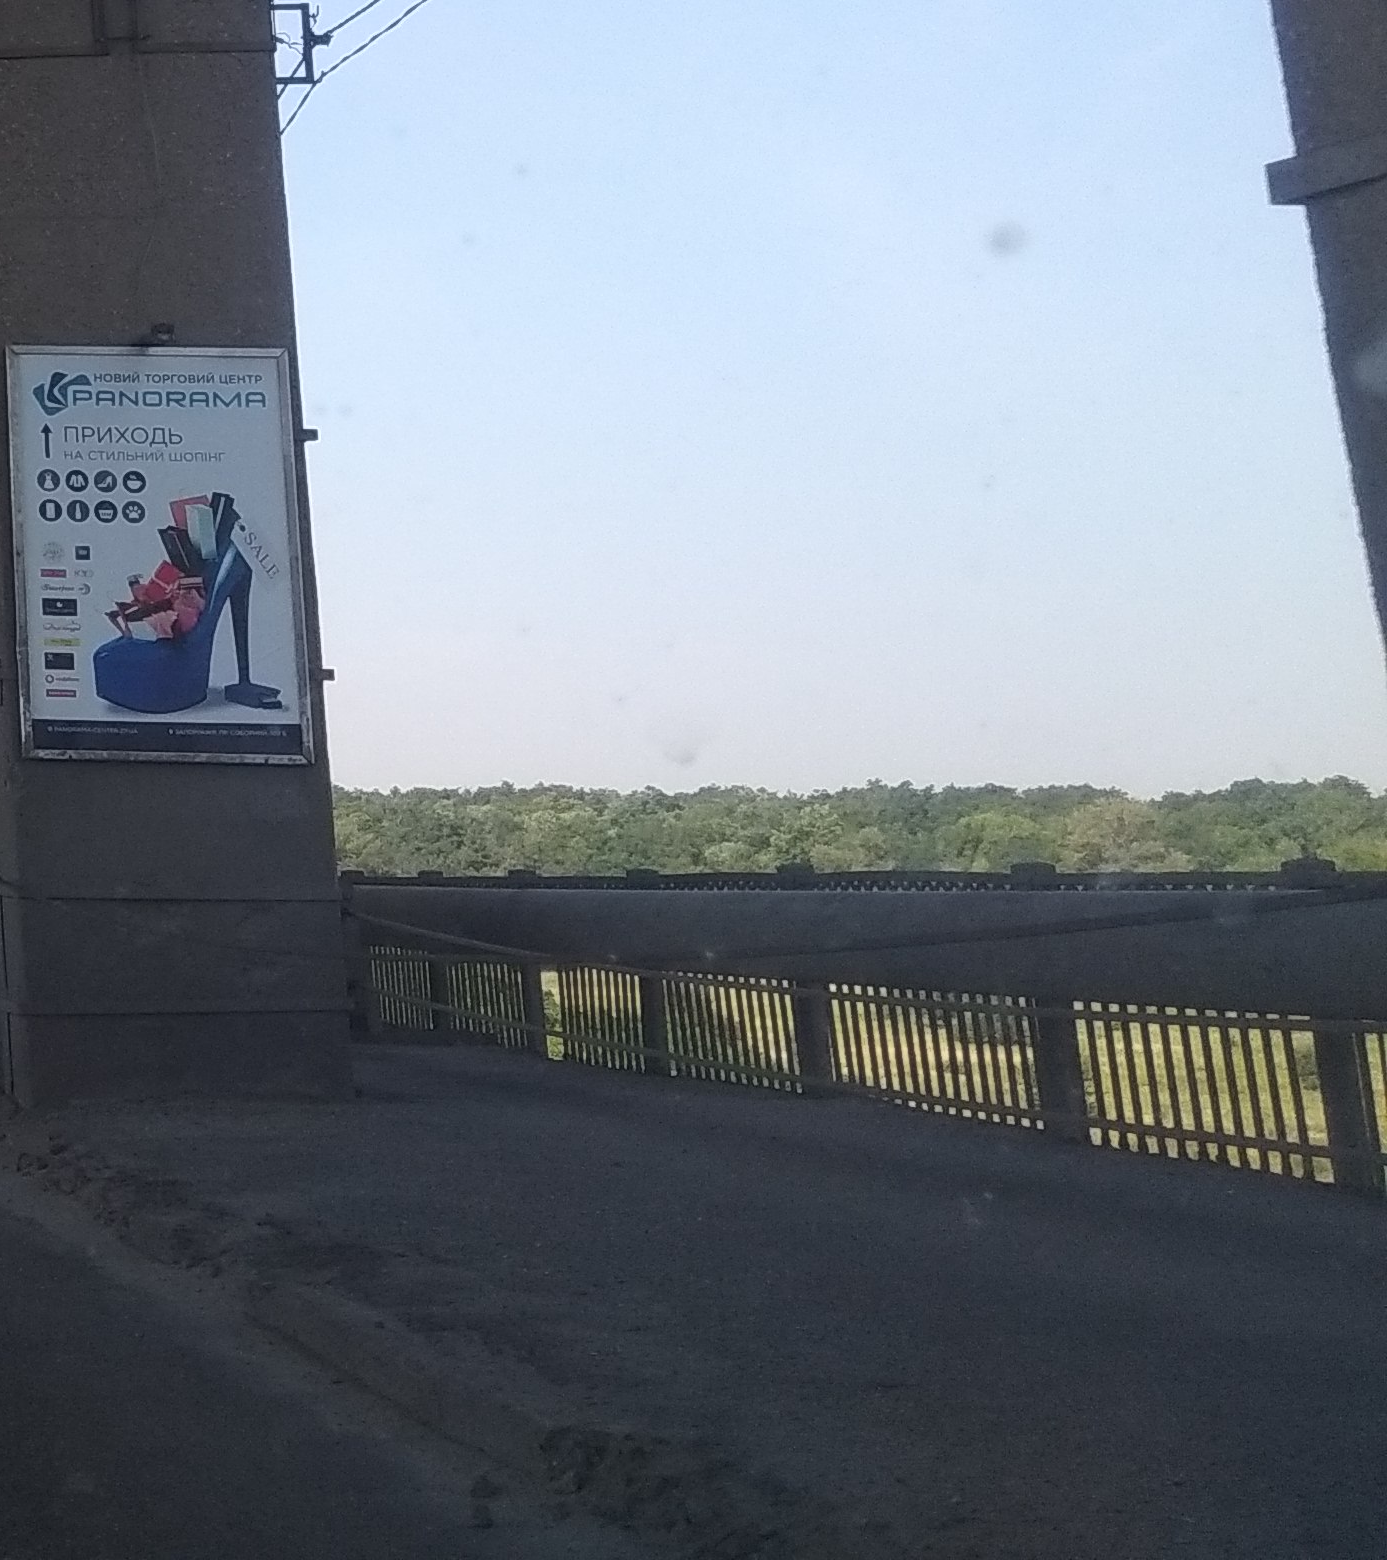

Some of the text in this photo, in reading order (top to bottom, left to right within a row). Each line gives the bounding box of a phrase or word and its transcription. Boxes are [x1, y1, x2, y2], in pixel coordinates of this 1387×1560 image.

[93, 371, 263, 386] НОВИЙ ТОРГОВИЙ ЦЕНТР
[72, 389, 267, 408] PANORAMA
[63, 425, 184, 448] ПРИХОДЬ
[63, 449, 226, 463] НА СТИЛЬНИЙ ШОПІНГ
[244, 532, 280, 579] SALE
